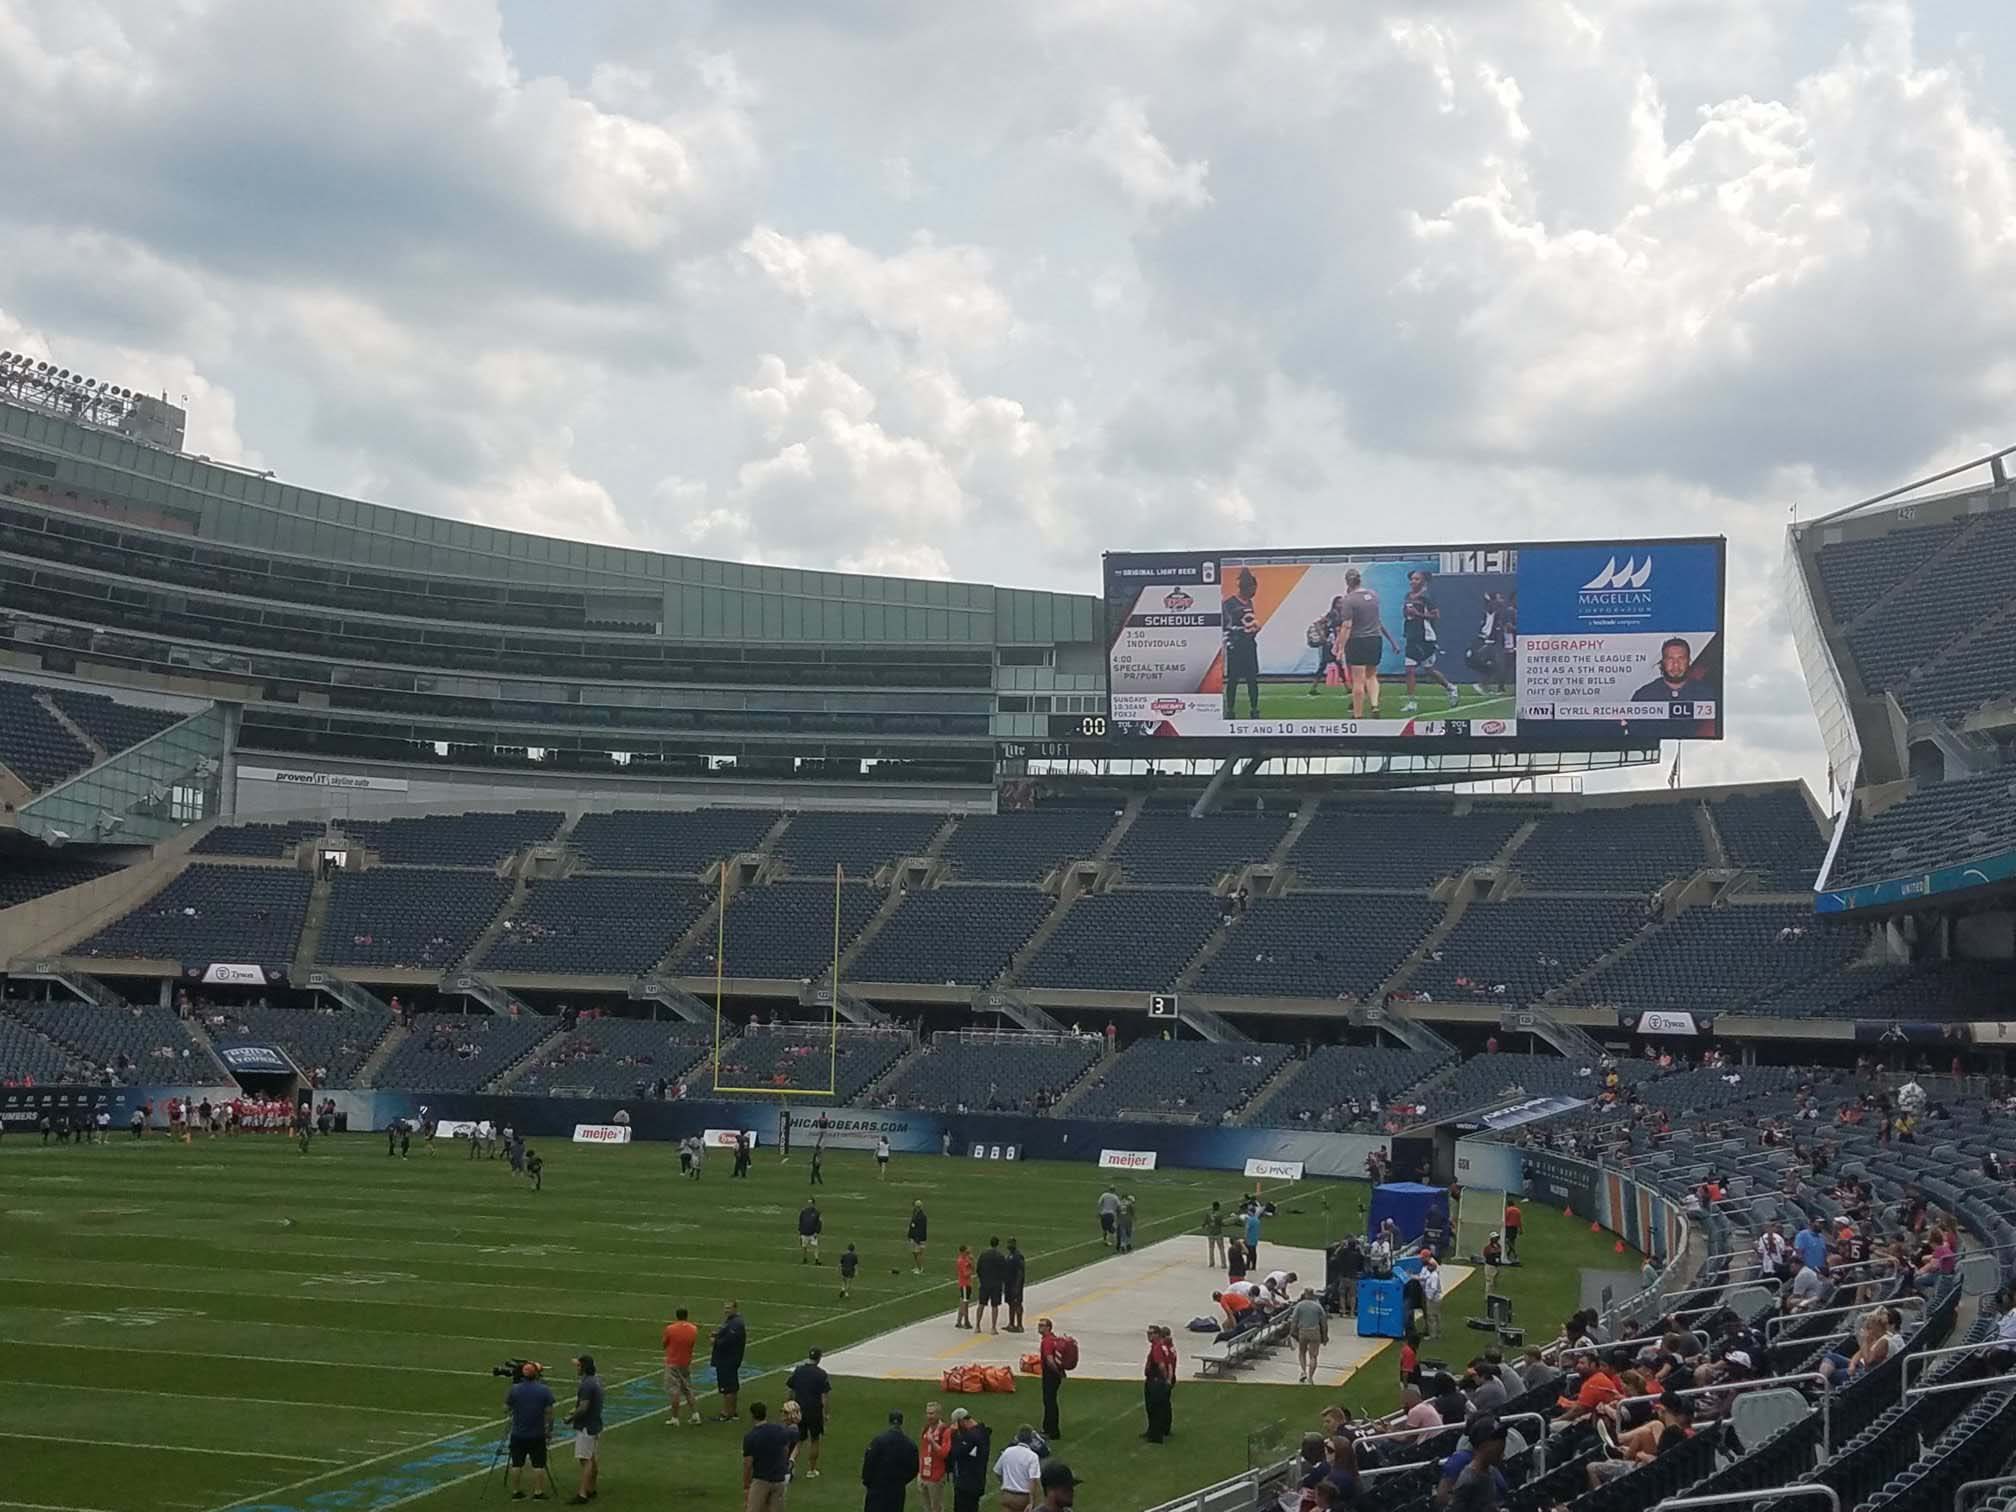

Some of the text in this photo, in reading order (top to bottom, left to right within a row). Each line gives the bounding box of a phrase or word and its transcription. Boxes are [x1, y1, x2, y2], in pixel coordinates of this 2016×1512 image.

[1123, 568, 1155, 576] ORIGINAL
[1579, 593, 1651, 604] MAGELLAN
[1144, 615, 1205, 626] SCHEDULE
[1126, 631, 1145, 639] 3:50
[1127, 640, 1187, 648] INDIVIDUALS
[1527, 640, 1604, 650] BIOGRAPHY
[1113, 655, 1132, 663] 4:00
[1527, 654, 1646, 663] ENTERED THE LEAGUE IN
[1113, 663, 1186, 672] SPECIAL TEAMS
[1526, 666, 1549, 674] 2014
[1552, 666, 1565, 674] AS
[1567, 666, 1574, 674] A
[1598, 665, 1632, 673] ROUND
[1123, 672, 1163, 680] PR/PUNT
[1527, 676, 1616, 685] PICK BY THE BILLS
[1548, 688, 1561, 696] OF
[1564, 687, 1600, 696] BAYLOR
[1560, 706, 1590, 715] CYRIL
[1593, 706, 1664, 715] RICHARDSON
[1672, 704, 1691, 715] OL
[1696, 705, 1712, 715] 73
[1229, 723, 1357, 734] 1ST AND 10 ON THE 50
[1041, 743, 1071, 756] LOFT
[276, 772, 313, 783] proven
[316, 774, 326, 784] IT
[231, 970, 254, 979] Tyson
[1154, 998, 1164, 1014] 3
[1662, 1019, 1686, 1029] Tyson
[789, 1117, 911, 1134] HICAOBEARS.COM
[1108, 1153, 1147, 1168] meijer
[1269, 1166, 1294, 1175] PNC
